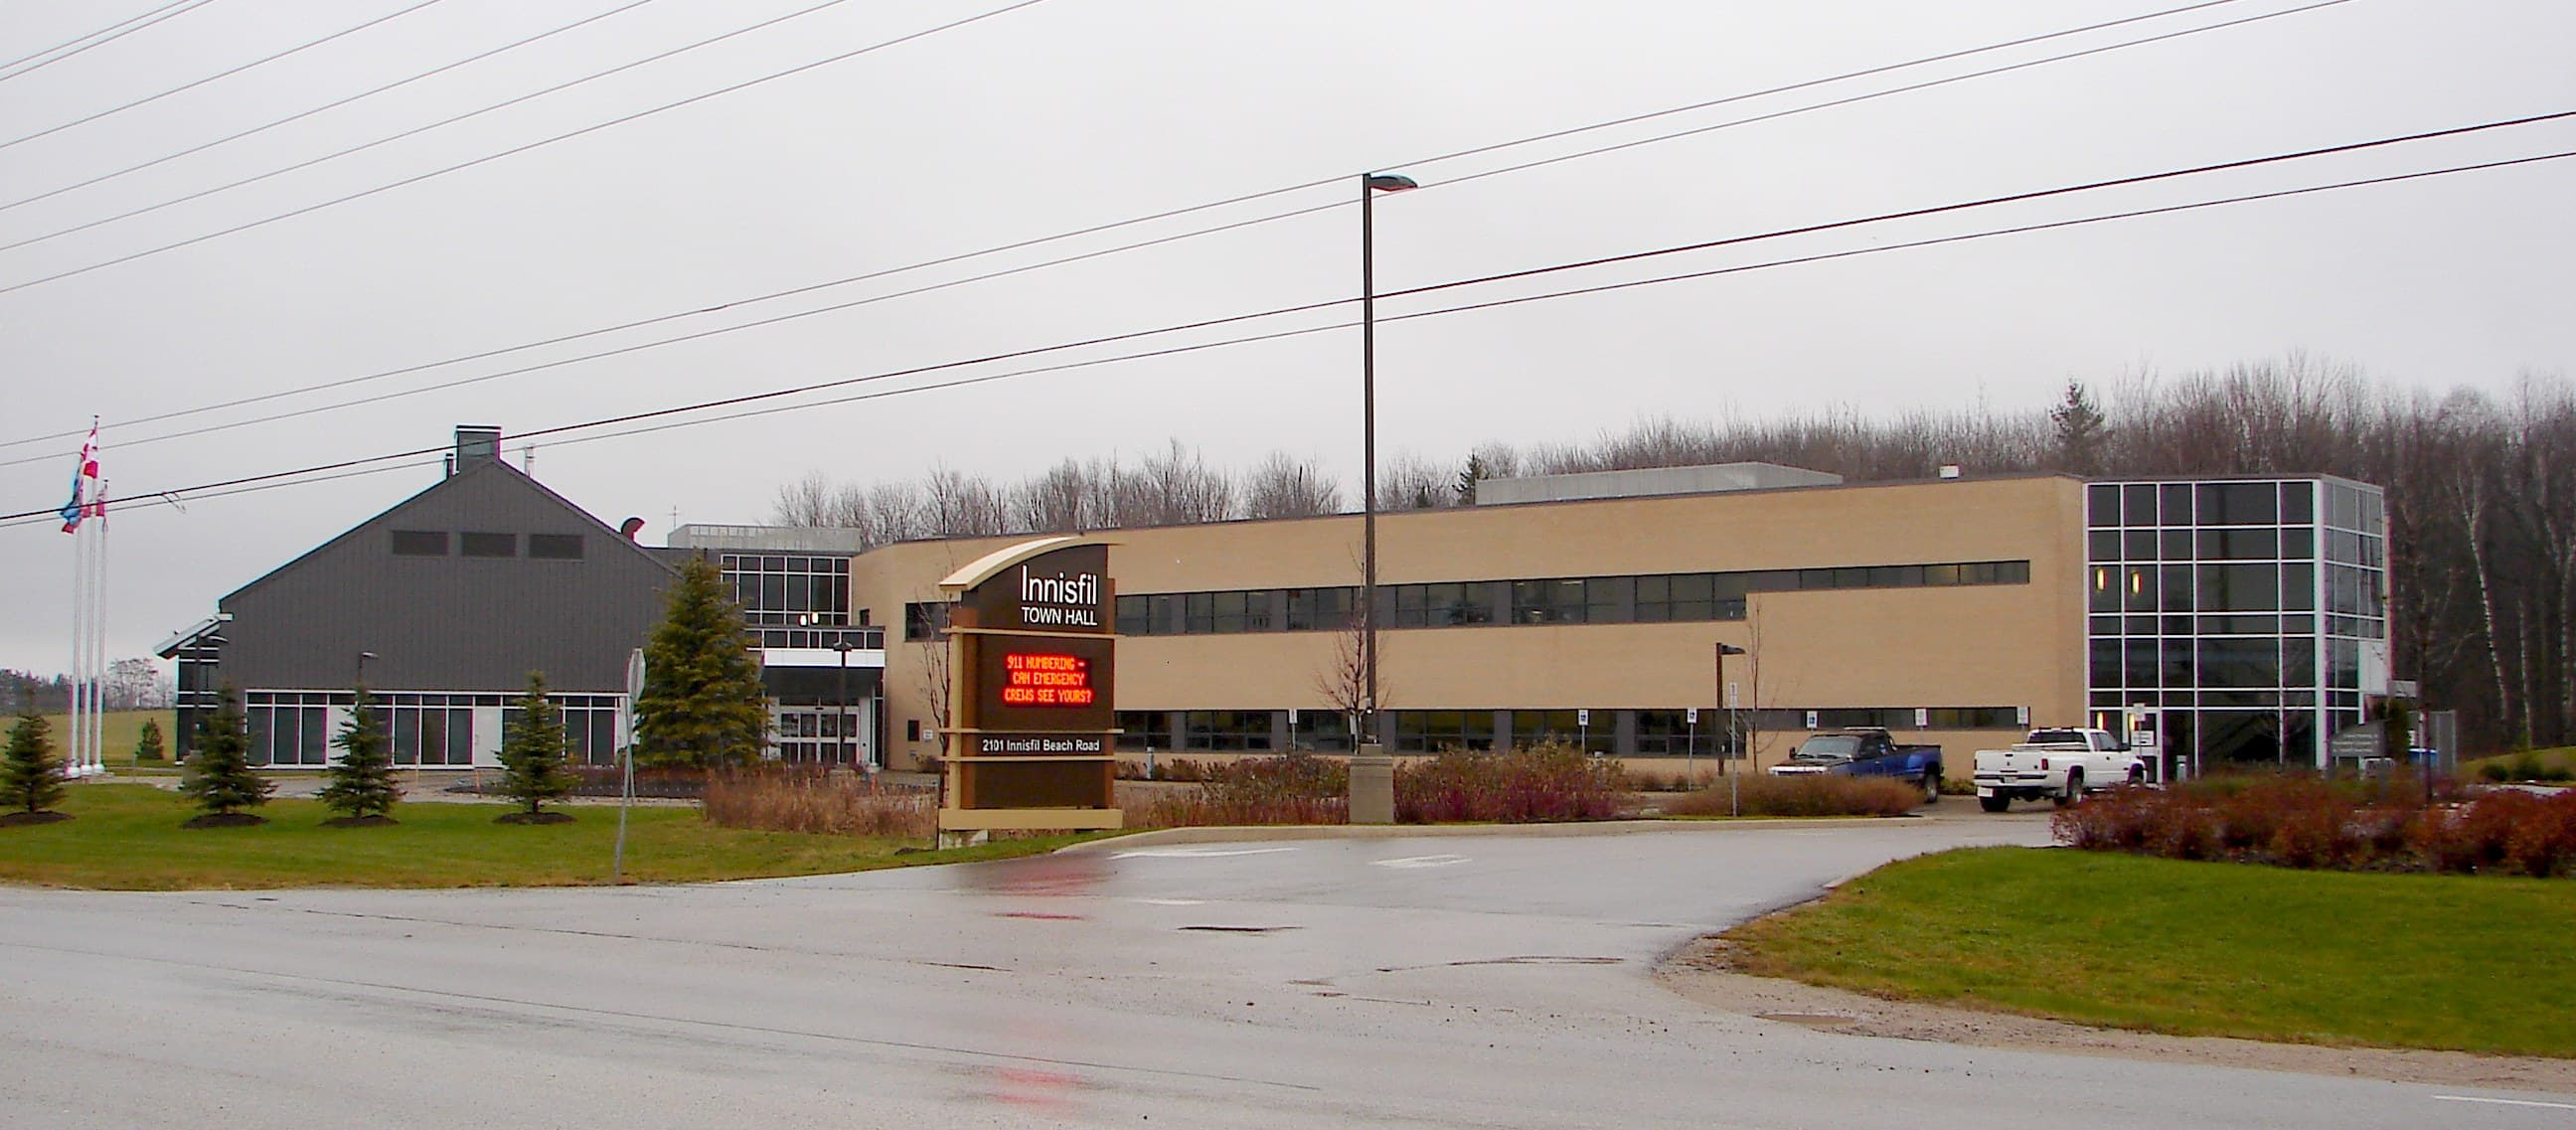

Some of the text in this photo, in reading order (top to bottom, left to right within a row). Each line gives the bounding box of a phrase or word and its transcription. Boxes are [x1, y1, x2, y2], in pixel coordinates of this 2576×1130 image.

[1021, 565, 1098, 605] Innisfil
[1022, 606, 1098, 625] TOWN HALL
[1007, 655, 1023, 669] 911
[1026, 656, 1074, 671] NUMBERING
[1013, 672, 1084, 686] CAN EMERGENCY
[1005, 688, 1092, 703] CREWS SEE YOURS?
[982, 739, 1100, 752] 2101 Innisfil Beach Road
